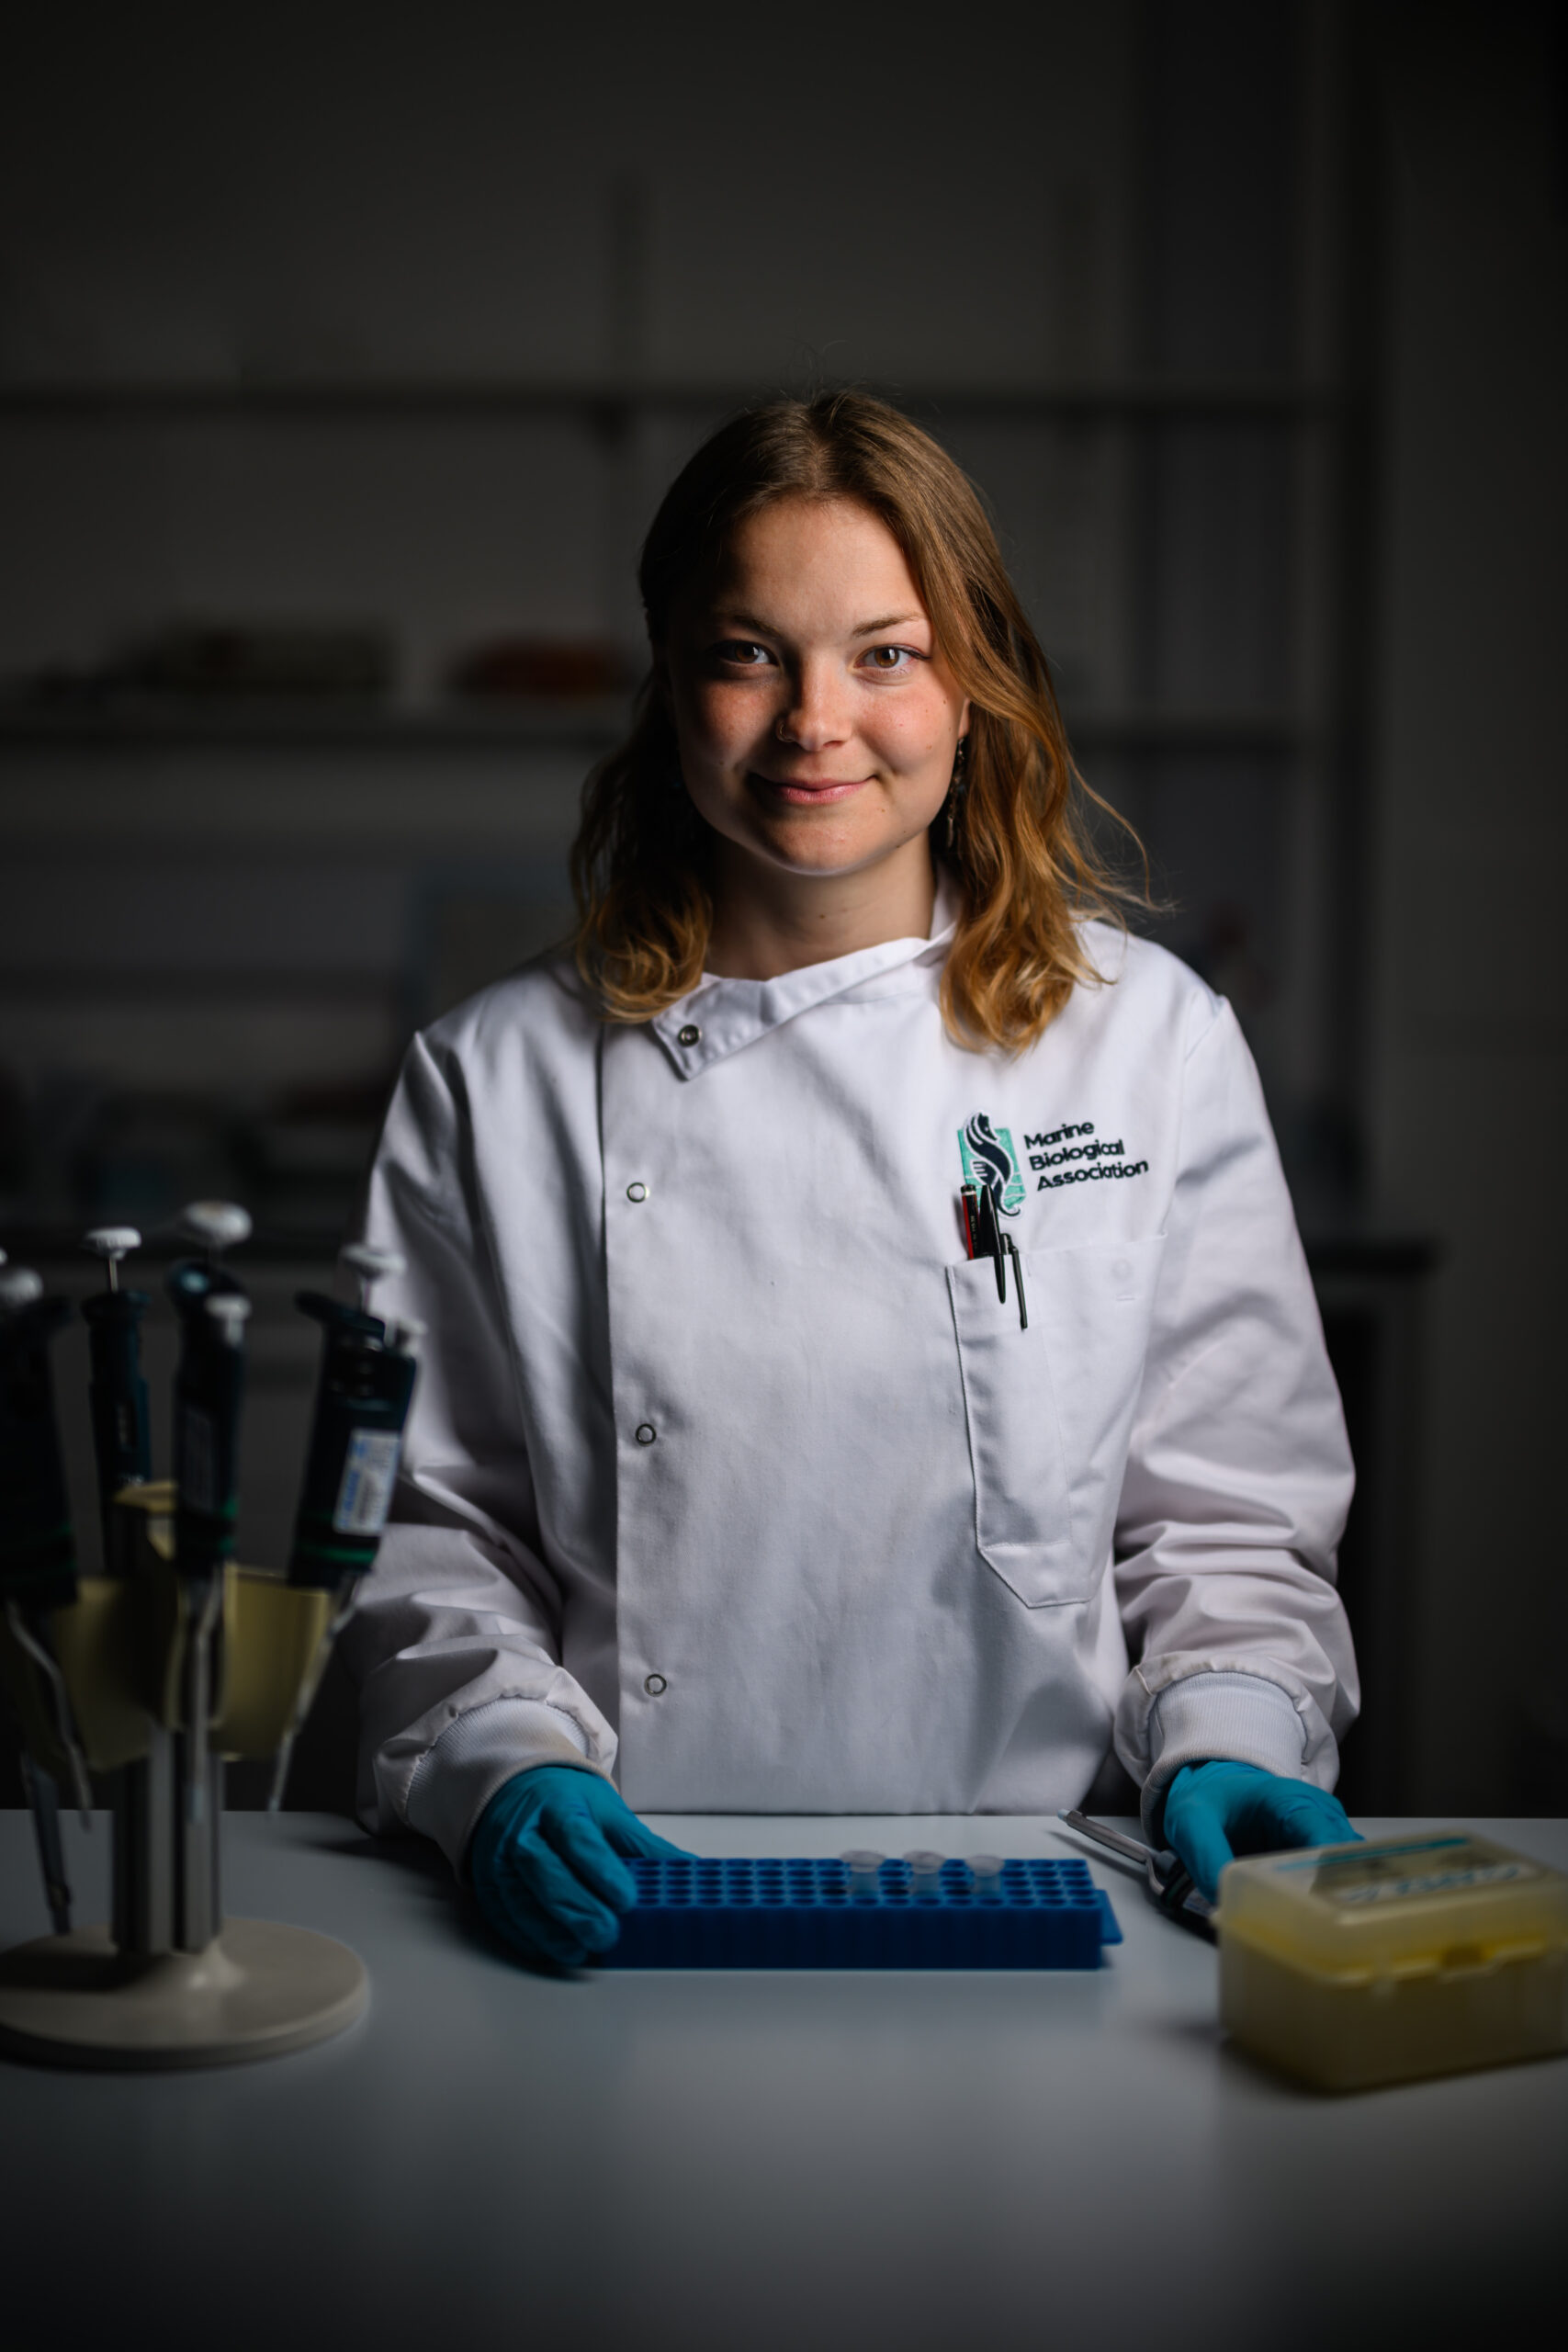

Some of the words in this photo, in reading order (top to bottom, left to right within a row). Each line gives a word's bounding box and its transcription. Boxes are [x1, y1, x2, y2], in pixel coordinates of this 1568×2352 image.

[1023, 1122, 1095, 1149] Marine
[1029, 1139, 1125, 1171] Biological
[1037, 1159, 1149, 1191] Association
